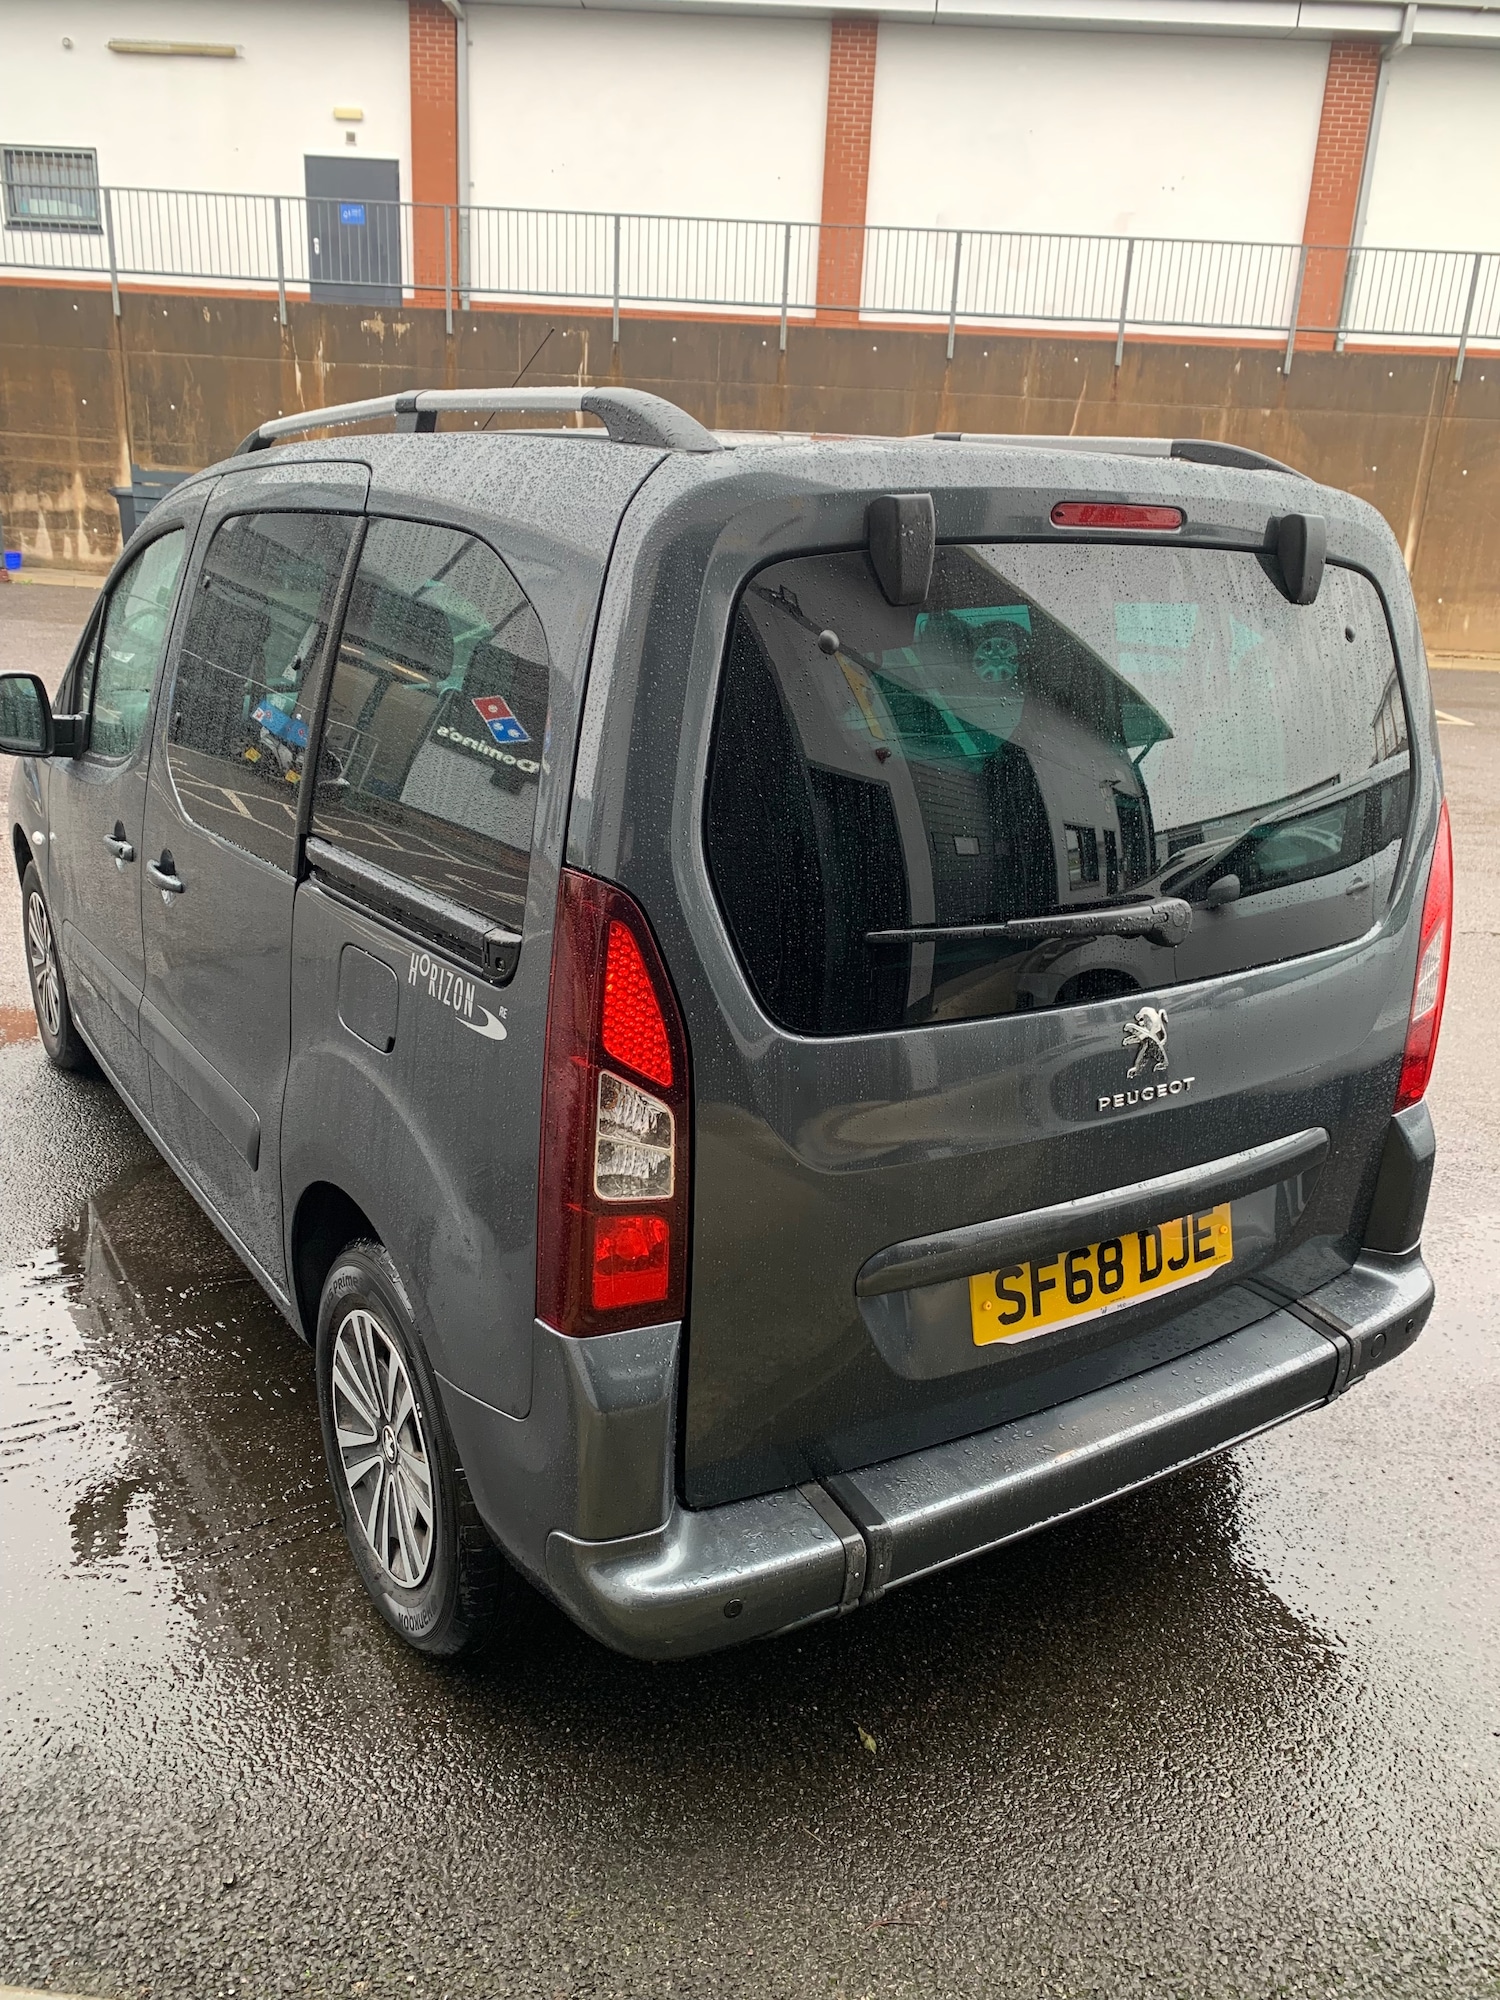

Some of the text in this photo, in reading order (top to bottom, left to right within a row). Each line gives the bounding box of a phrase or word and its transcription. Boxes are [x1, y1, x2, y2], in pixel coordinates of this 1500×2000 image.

[408, 953, 476, 1019] HORIZON
[1097, 1076, 1196, 1112] PEUGEOT
[994, 1207, 1216, 1326] SF68 DJE
